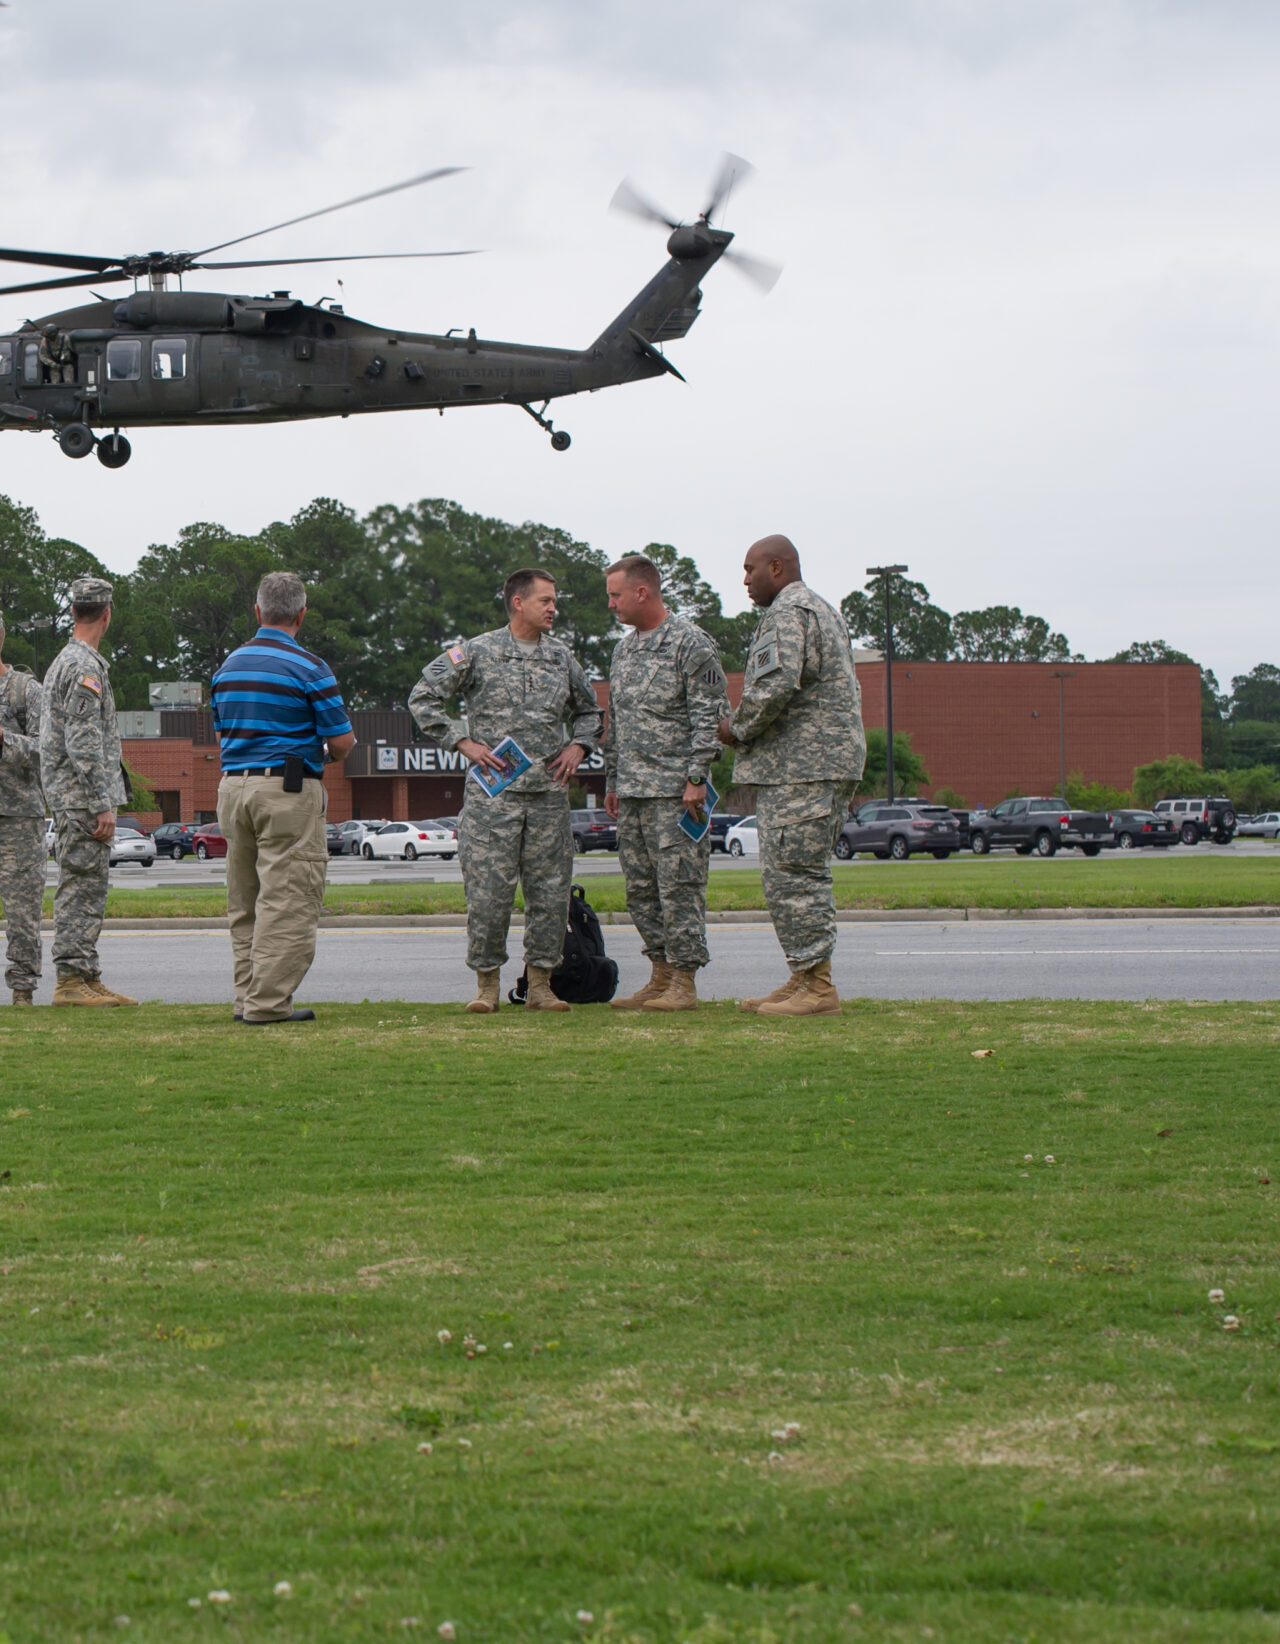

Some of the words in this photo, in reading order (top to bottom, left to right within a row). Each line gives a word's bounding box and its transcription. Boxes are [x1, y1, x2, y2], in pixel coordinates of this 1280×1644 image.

[433, 368, 469, 377] UNITED
[474, 368, 514, 377] STATES
[519, 368, 546, 377] ARMY
